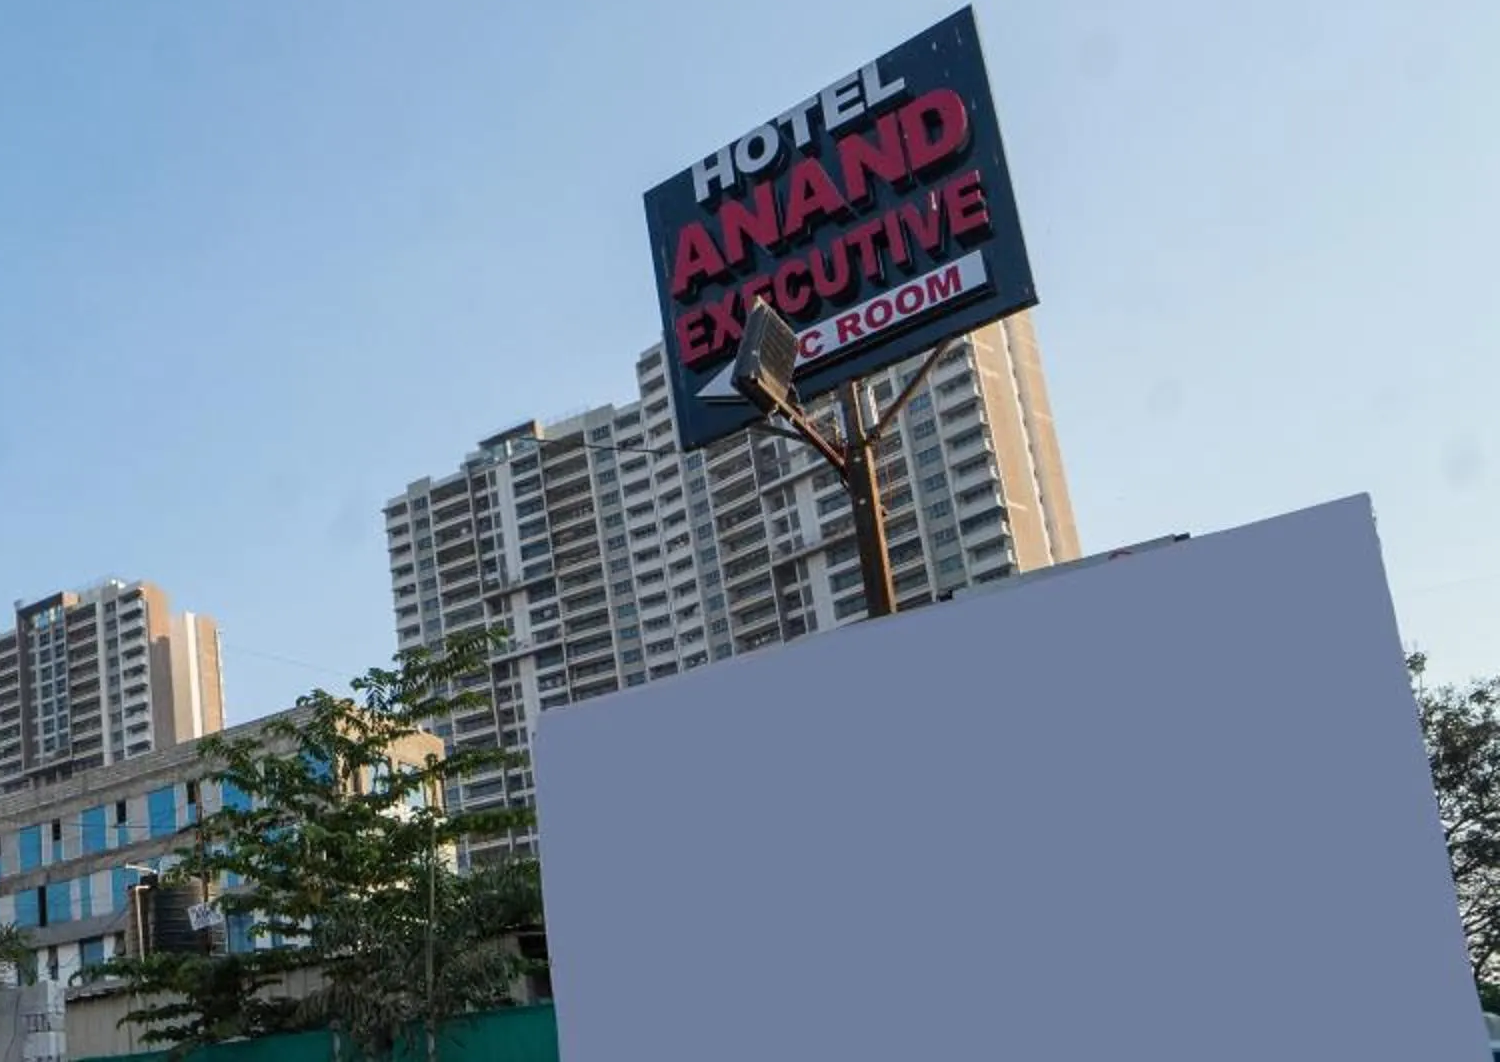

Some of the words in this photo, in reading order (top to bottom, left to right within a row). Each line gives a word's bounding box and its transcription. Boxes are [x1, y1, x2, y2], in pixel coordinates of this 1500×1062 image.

[670, 88, 968, 299] ANAND
[690, 59, 905, 203] HOTEL
[836, 265, 964, 345] ROOM
